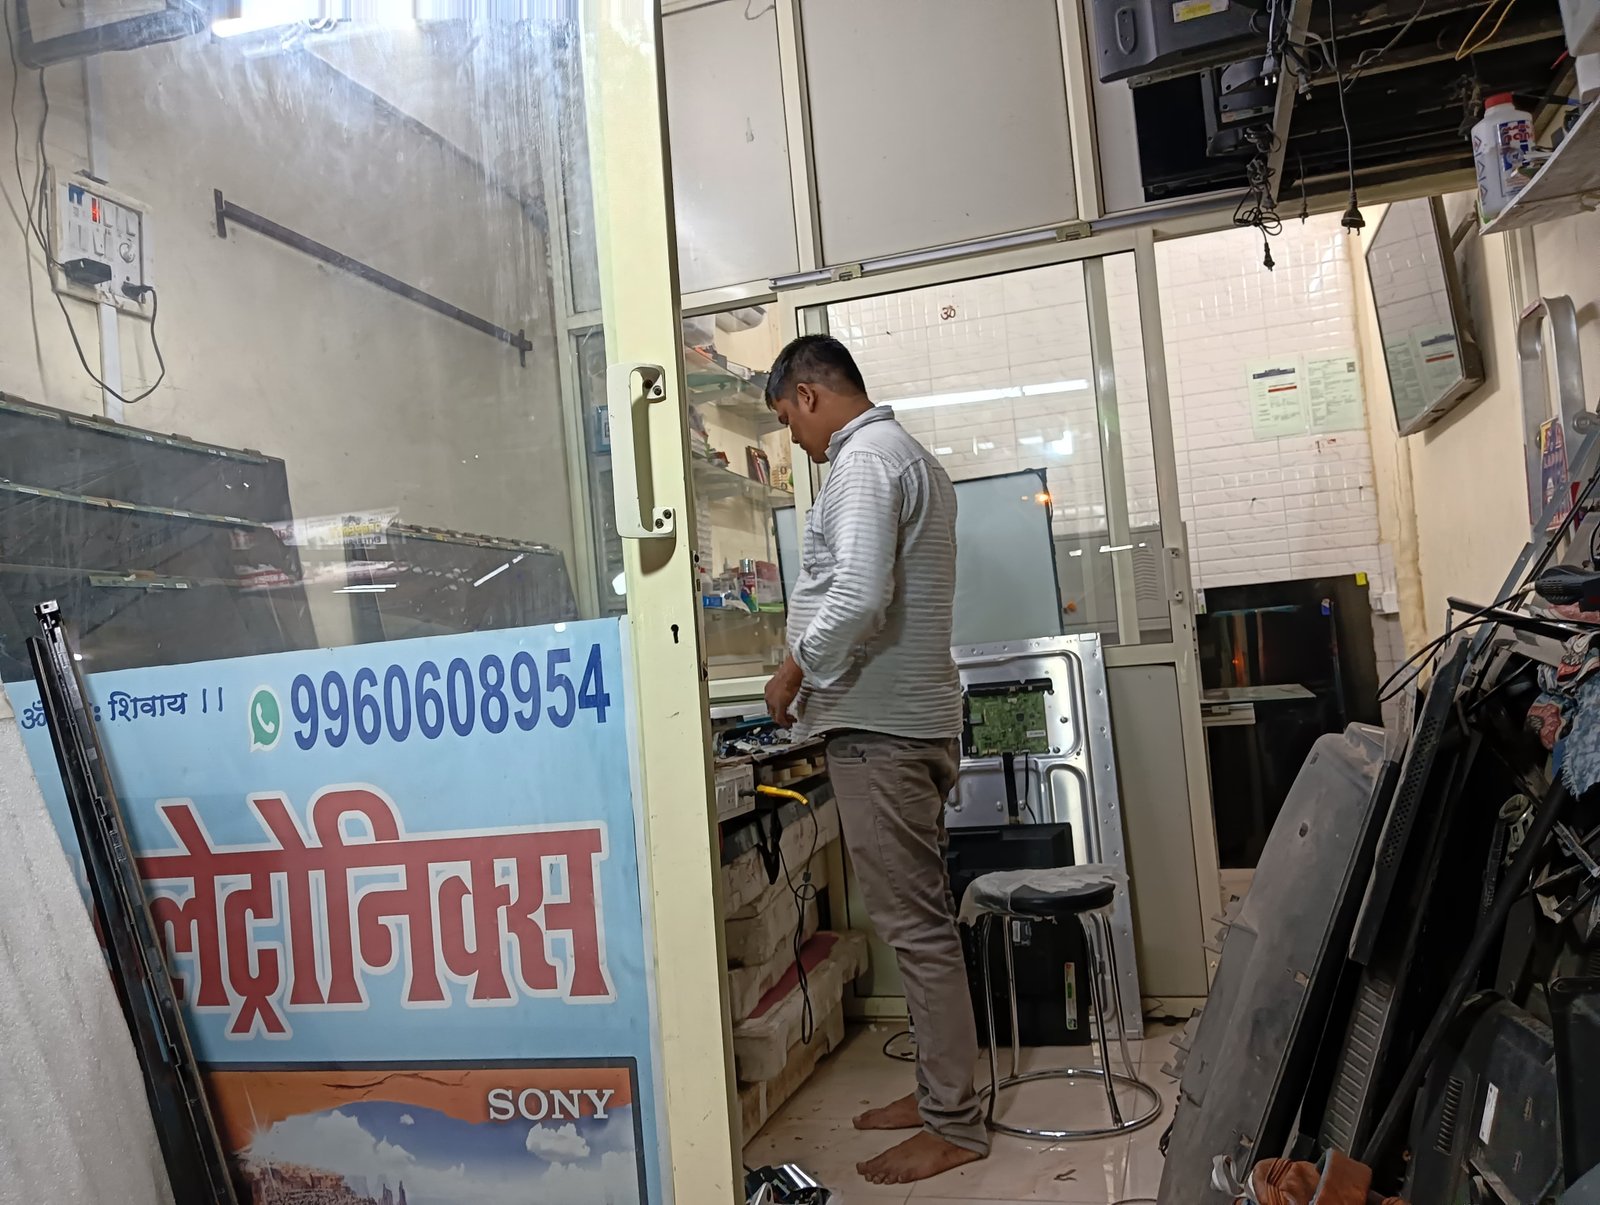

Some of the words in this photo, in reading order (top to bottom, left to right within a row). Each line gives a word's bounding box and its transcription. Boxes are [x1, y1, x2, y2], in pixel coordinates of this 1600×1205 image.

[108, 691, 188, 722] शिवाय
[291, 643, 611, 751] 9960608954
[95, 788, 609, 1034] लेट्रोनिक्स
[488, 1088, 615, 1120] SONY
